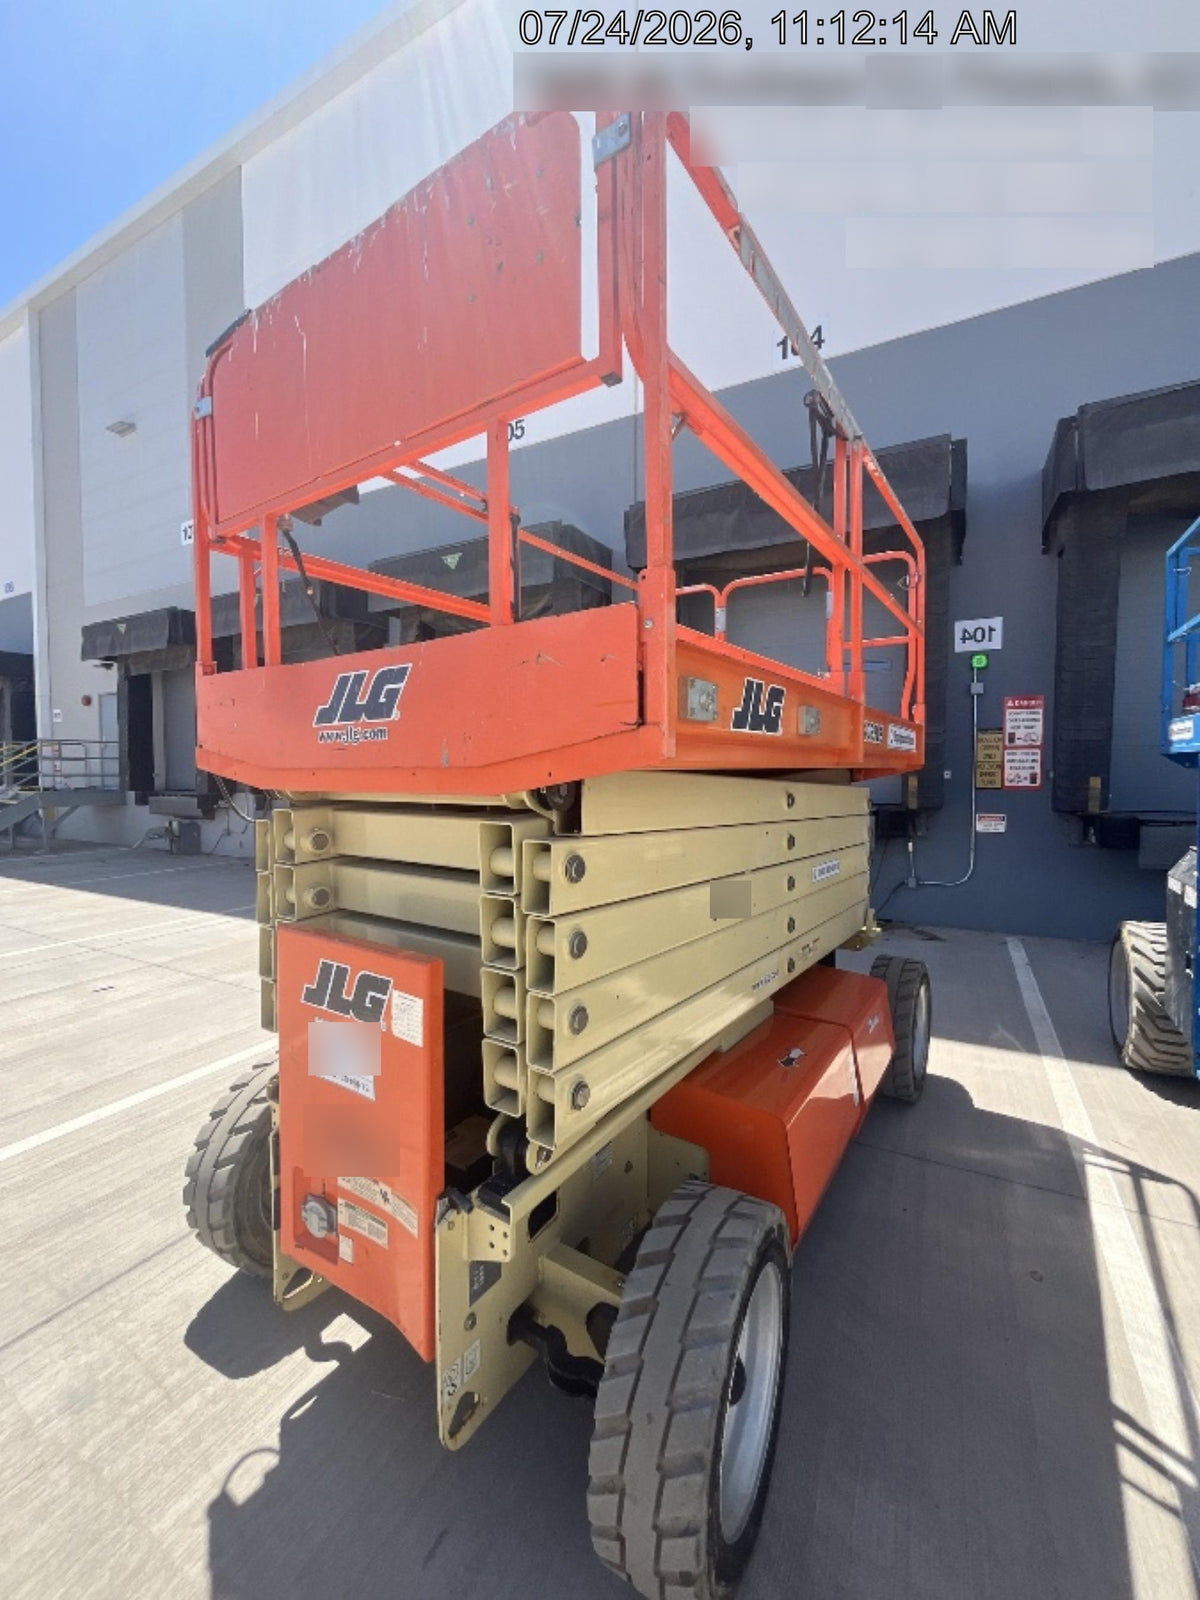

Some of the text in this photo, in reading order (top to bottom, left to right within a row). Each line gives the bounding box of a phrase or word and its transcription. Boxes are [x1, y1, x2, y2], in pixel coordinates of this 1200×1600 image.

[776, 325, 825, 360] 14
[313, 663, 412, 727] JLG
[731, 677, 786, 736] JLG
[300, 958, 393, 1024] JLG
